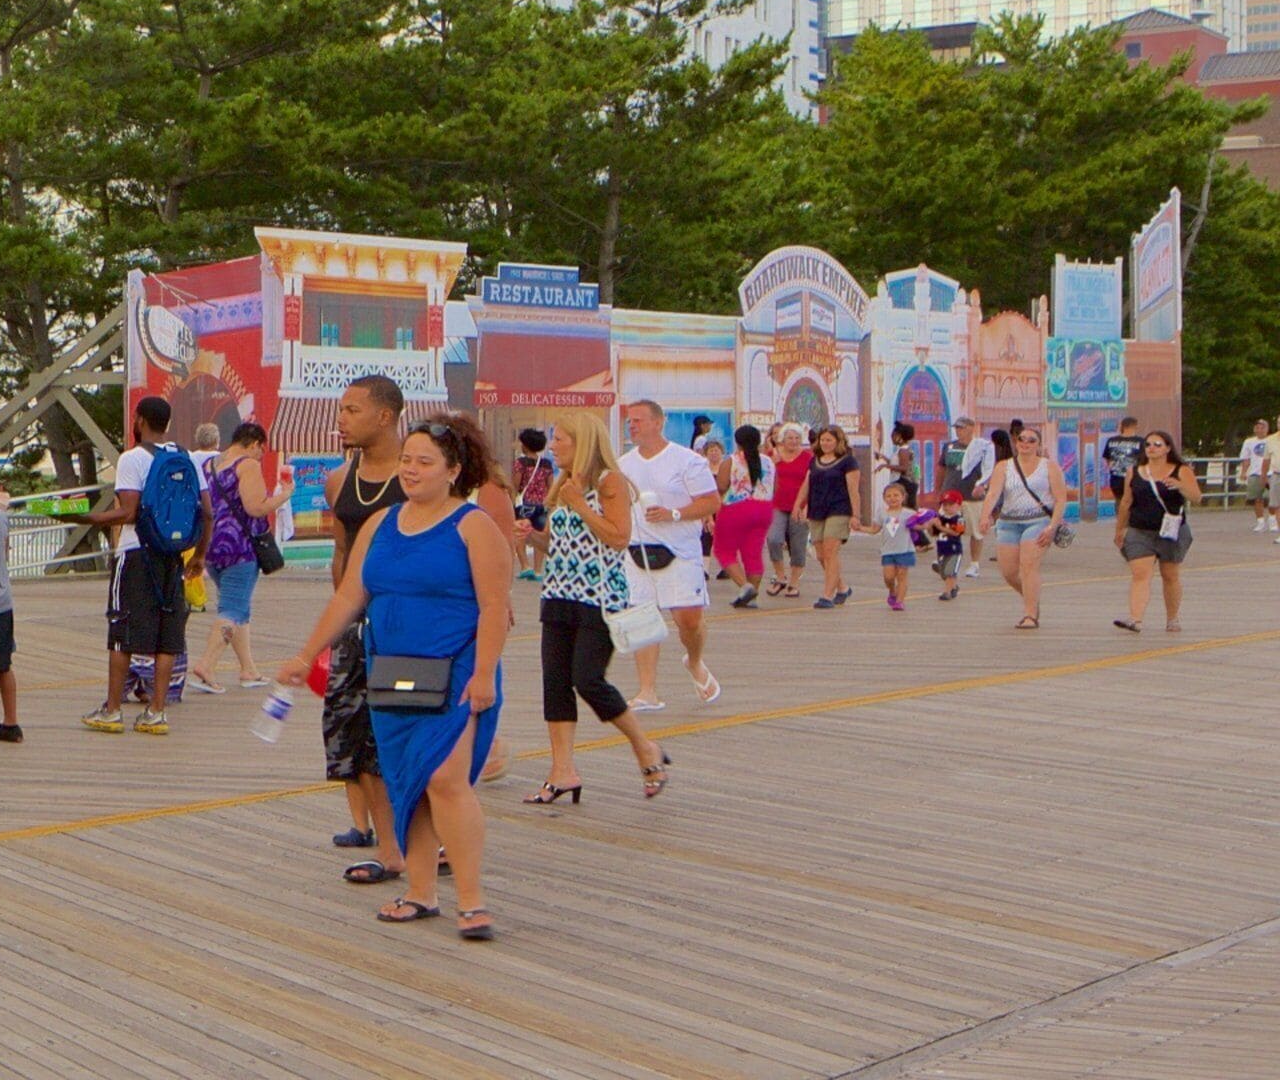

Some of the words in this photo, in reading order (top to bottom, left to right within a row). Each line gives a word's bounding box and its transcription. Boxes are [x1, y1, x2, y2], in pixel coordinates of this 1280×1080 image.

[490, 283, 595, 308] RESTAURANT
[744, 255, 820, 311] BOARDWALK
[822, 261, 868, 325] EMPIRE
[511, 392, 586, 405] DELICATESSEN
